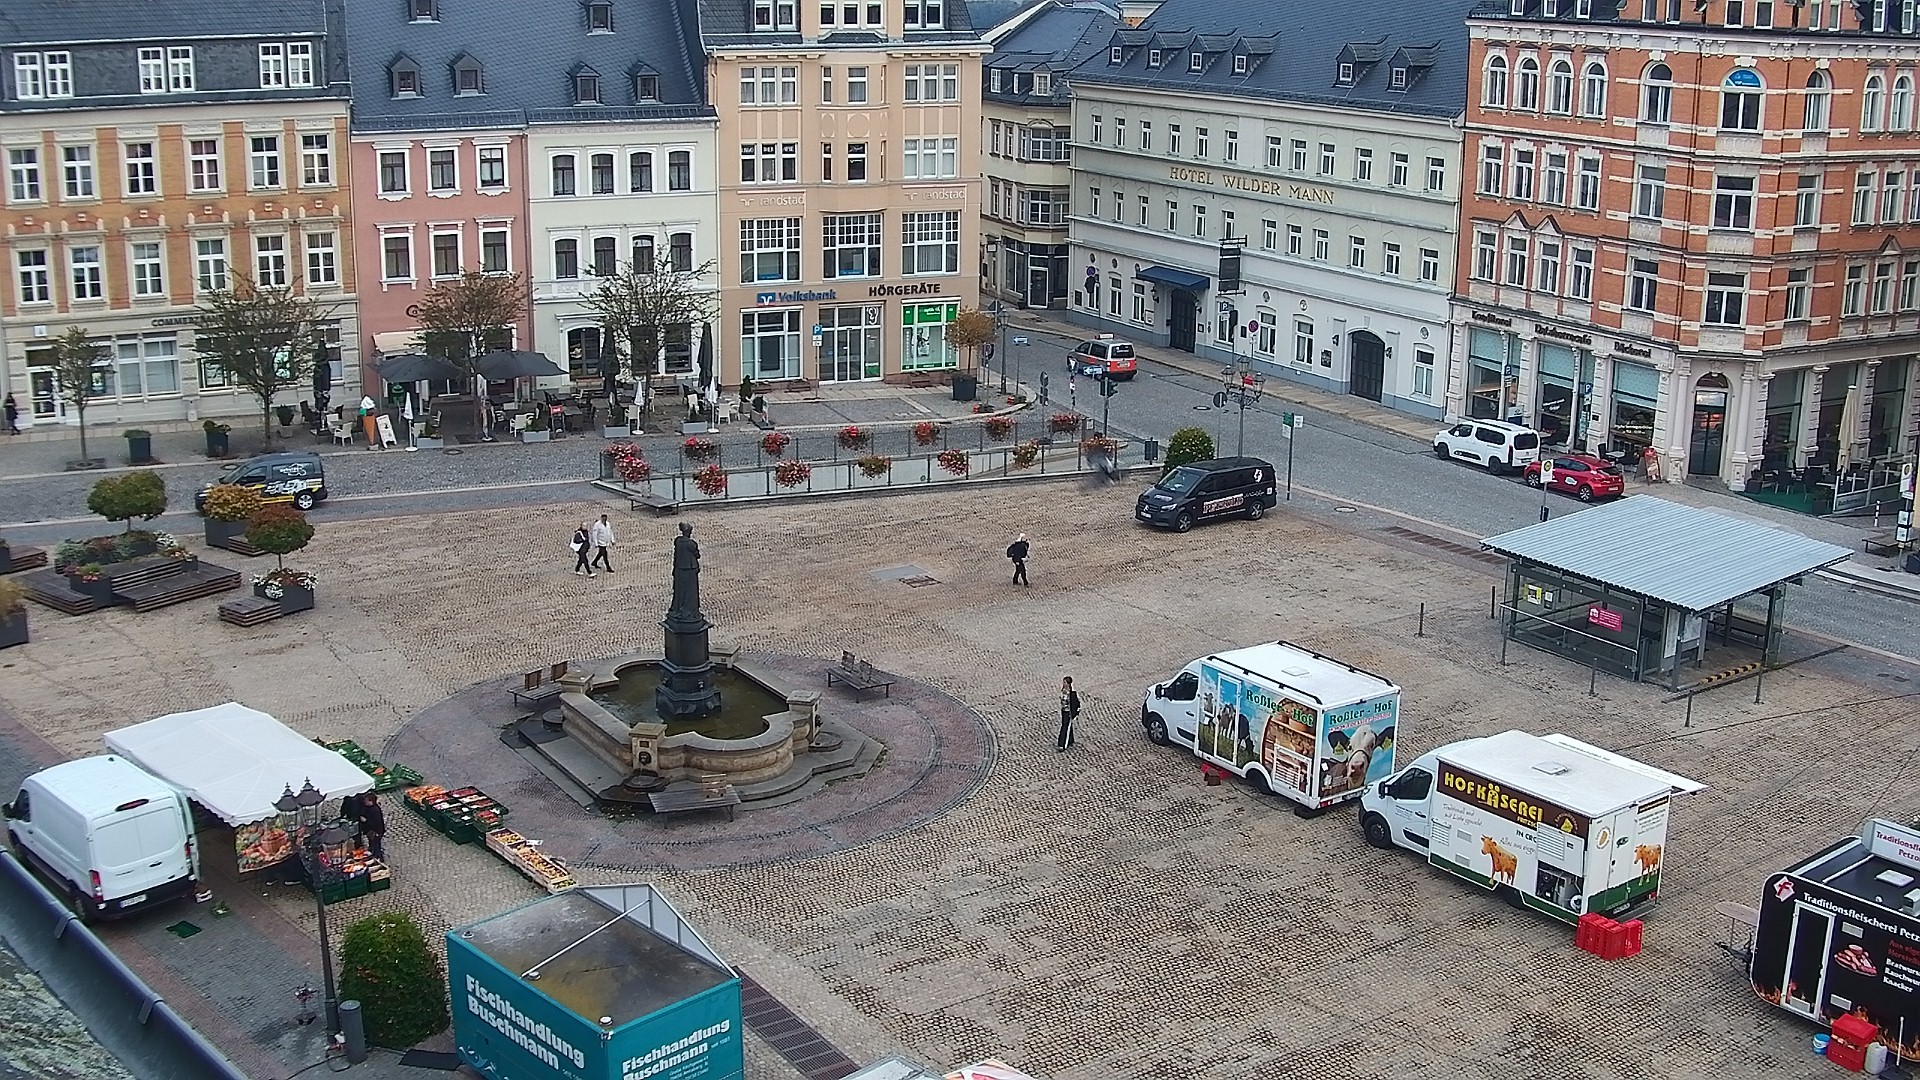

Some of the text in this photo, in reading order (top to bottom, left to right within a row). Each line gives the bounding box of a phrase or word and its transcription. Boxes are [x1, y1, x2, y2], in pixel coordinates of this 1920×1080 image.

[1169, 166, 1335, 205] HOTEL WILDER MANN
[778, 289, 837, 302] Volksbank
[868, 283, 941, 297] HÖRGERÄTE
[1293, 708, 1314, 727] Hof
[1329, 709, 1364, 725] Roßler
[1374, 700, 1393, 713] Hof
[1877, 831, 1920, 851] Traditionsfl
[1899, 849, 1920, 862] Petzo
[1803, 892, 1898, 934] Traditionsfleischerei
[466, 974, 585, 1069] Fischhandlung
[467, 994, 559, 1070] Buschmann
[622, 1019, 730, 1074] Fischhandlung
[623, 1042, 708, 1080] Buschmann
